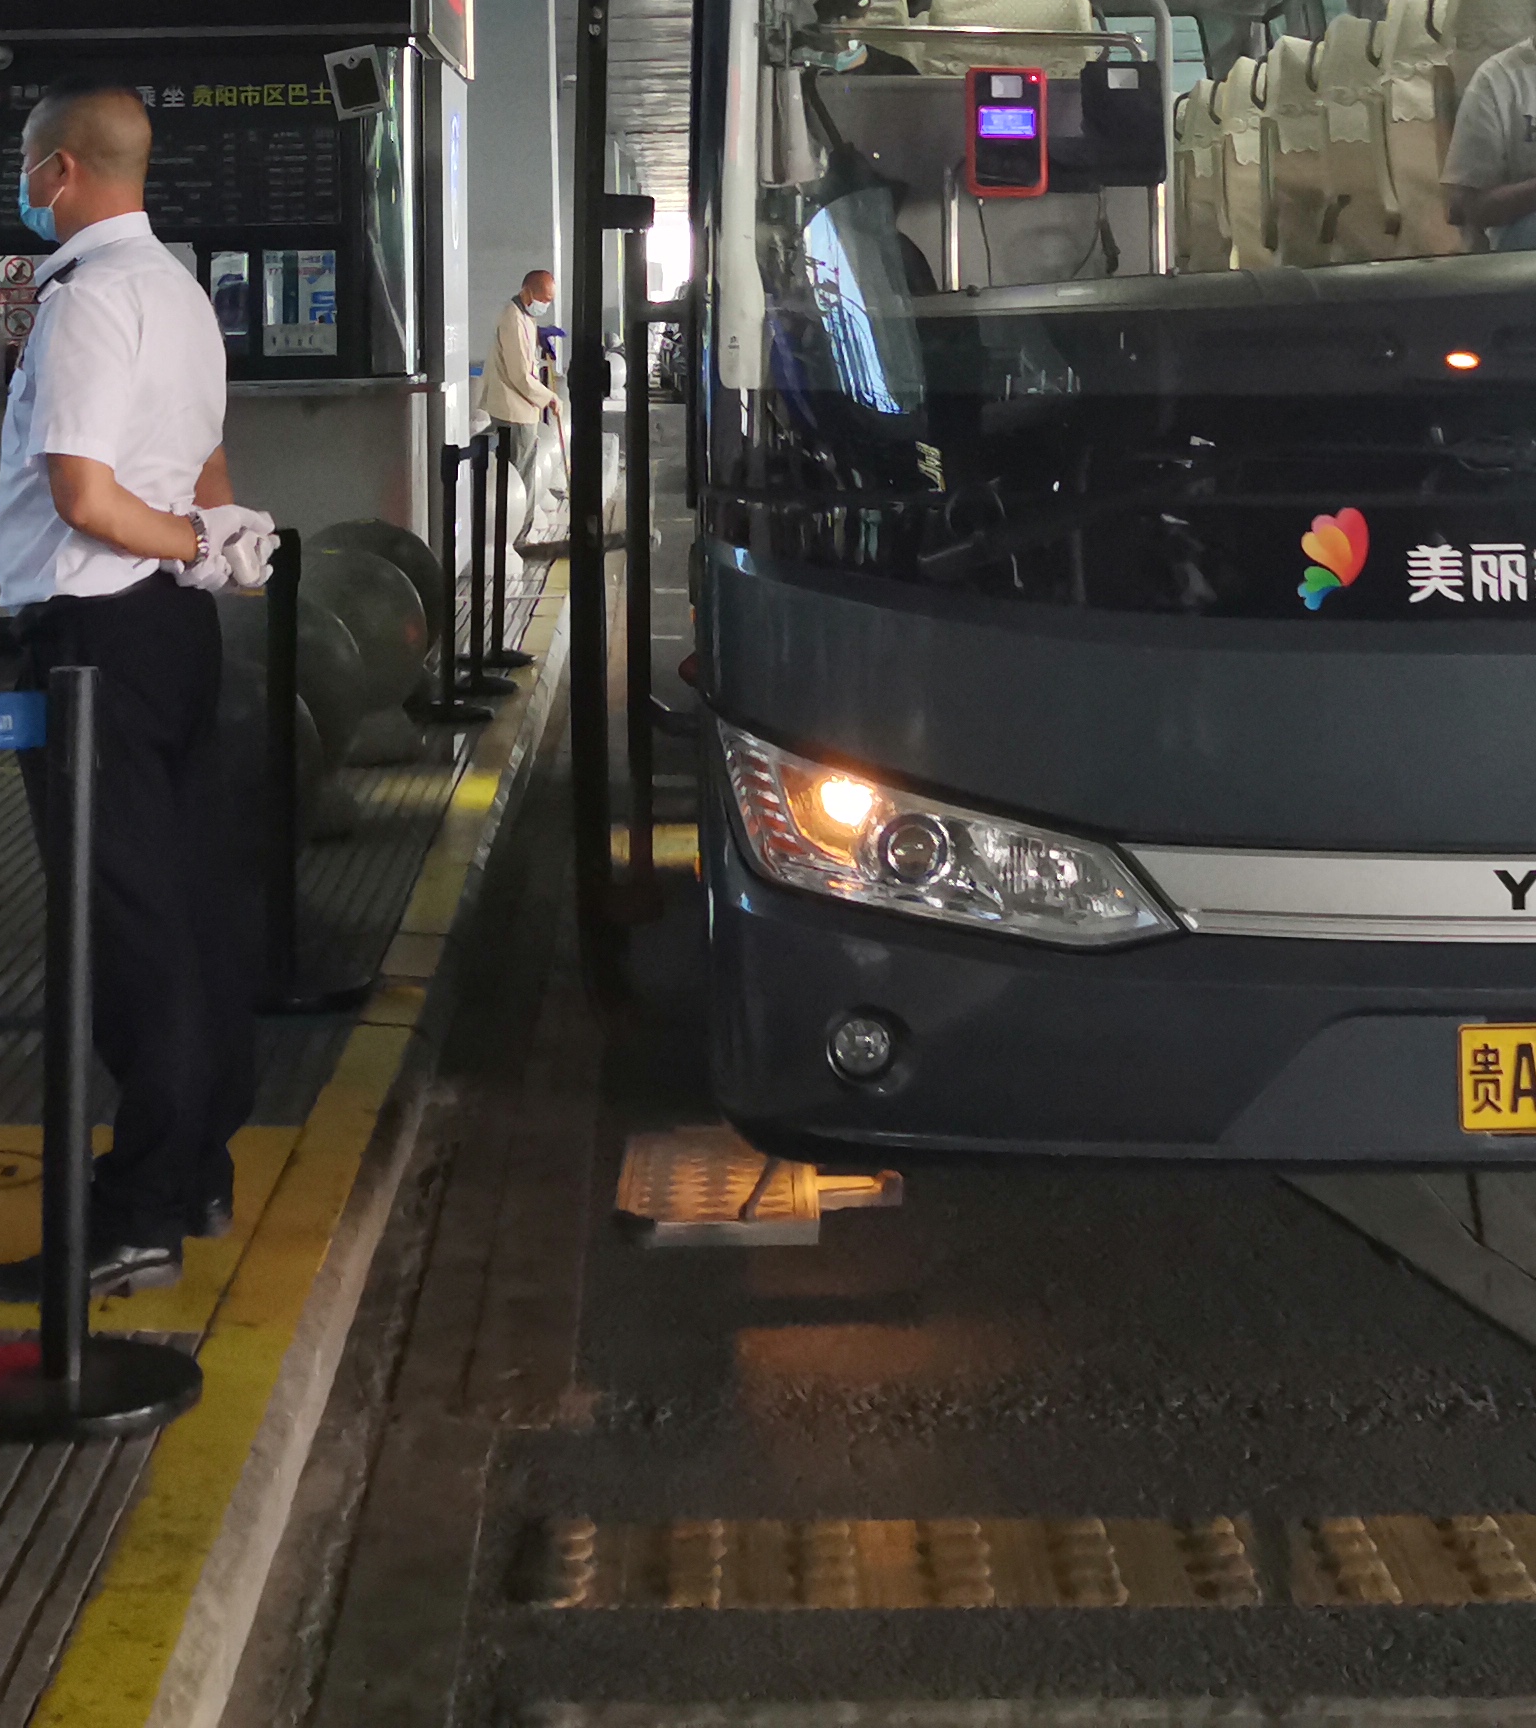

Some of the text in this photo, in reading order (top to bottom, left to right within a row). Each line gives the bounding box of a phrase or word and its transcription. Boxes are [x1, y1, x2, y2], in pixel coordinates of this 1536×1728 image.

[191, 82, 332, 107] 贵阳市区巴士
